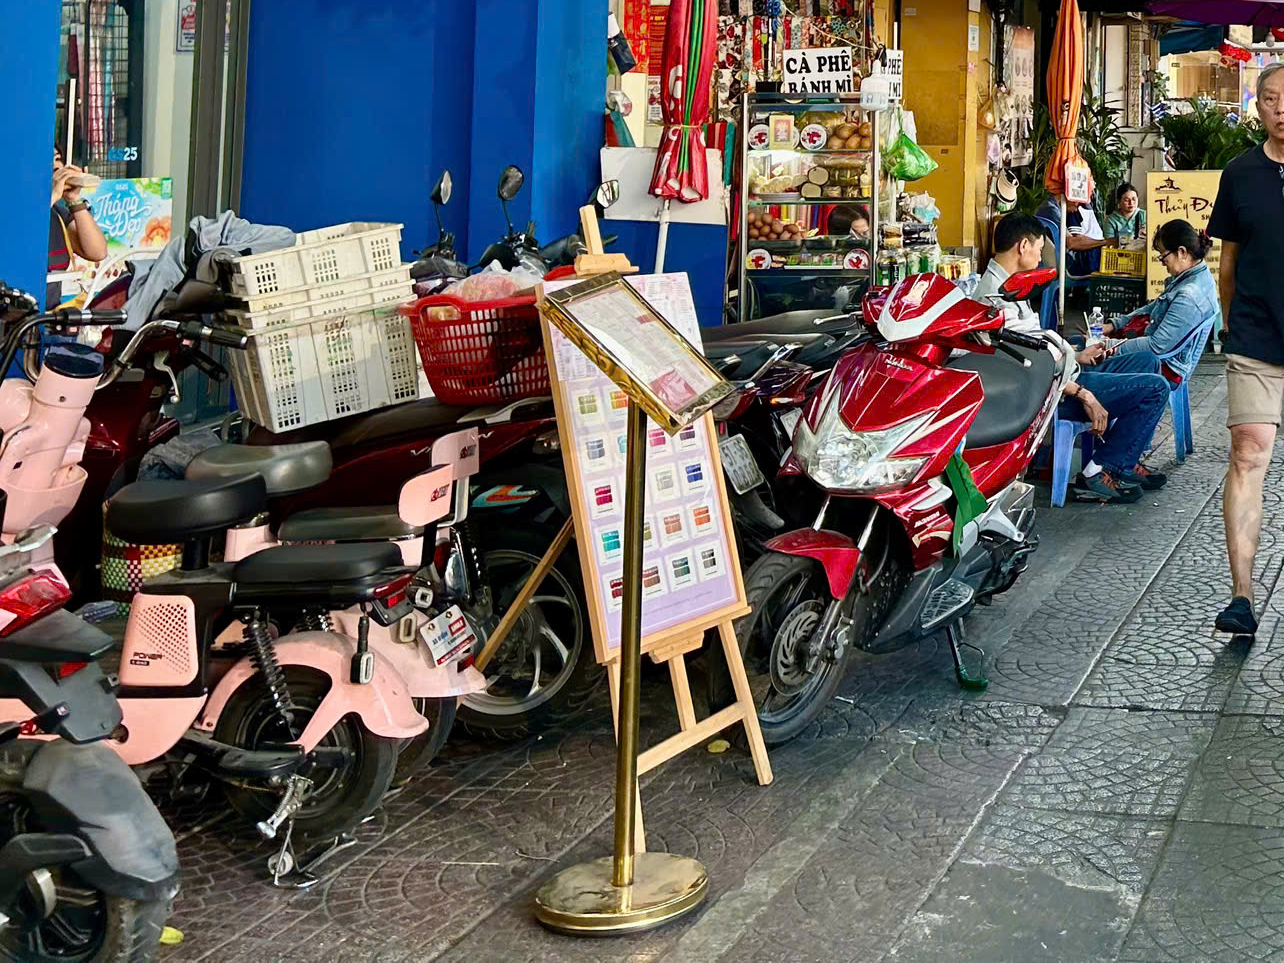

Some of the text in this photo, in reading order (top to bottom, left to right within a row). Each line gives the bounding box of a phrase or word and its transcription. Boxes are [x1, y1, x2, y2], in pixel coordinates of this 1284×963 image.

[785, 49, 851, 74] CÀ PHÊ
[787, 74, 852, 93] BÁNH MÌ
